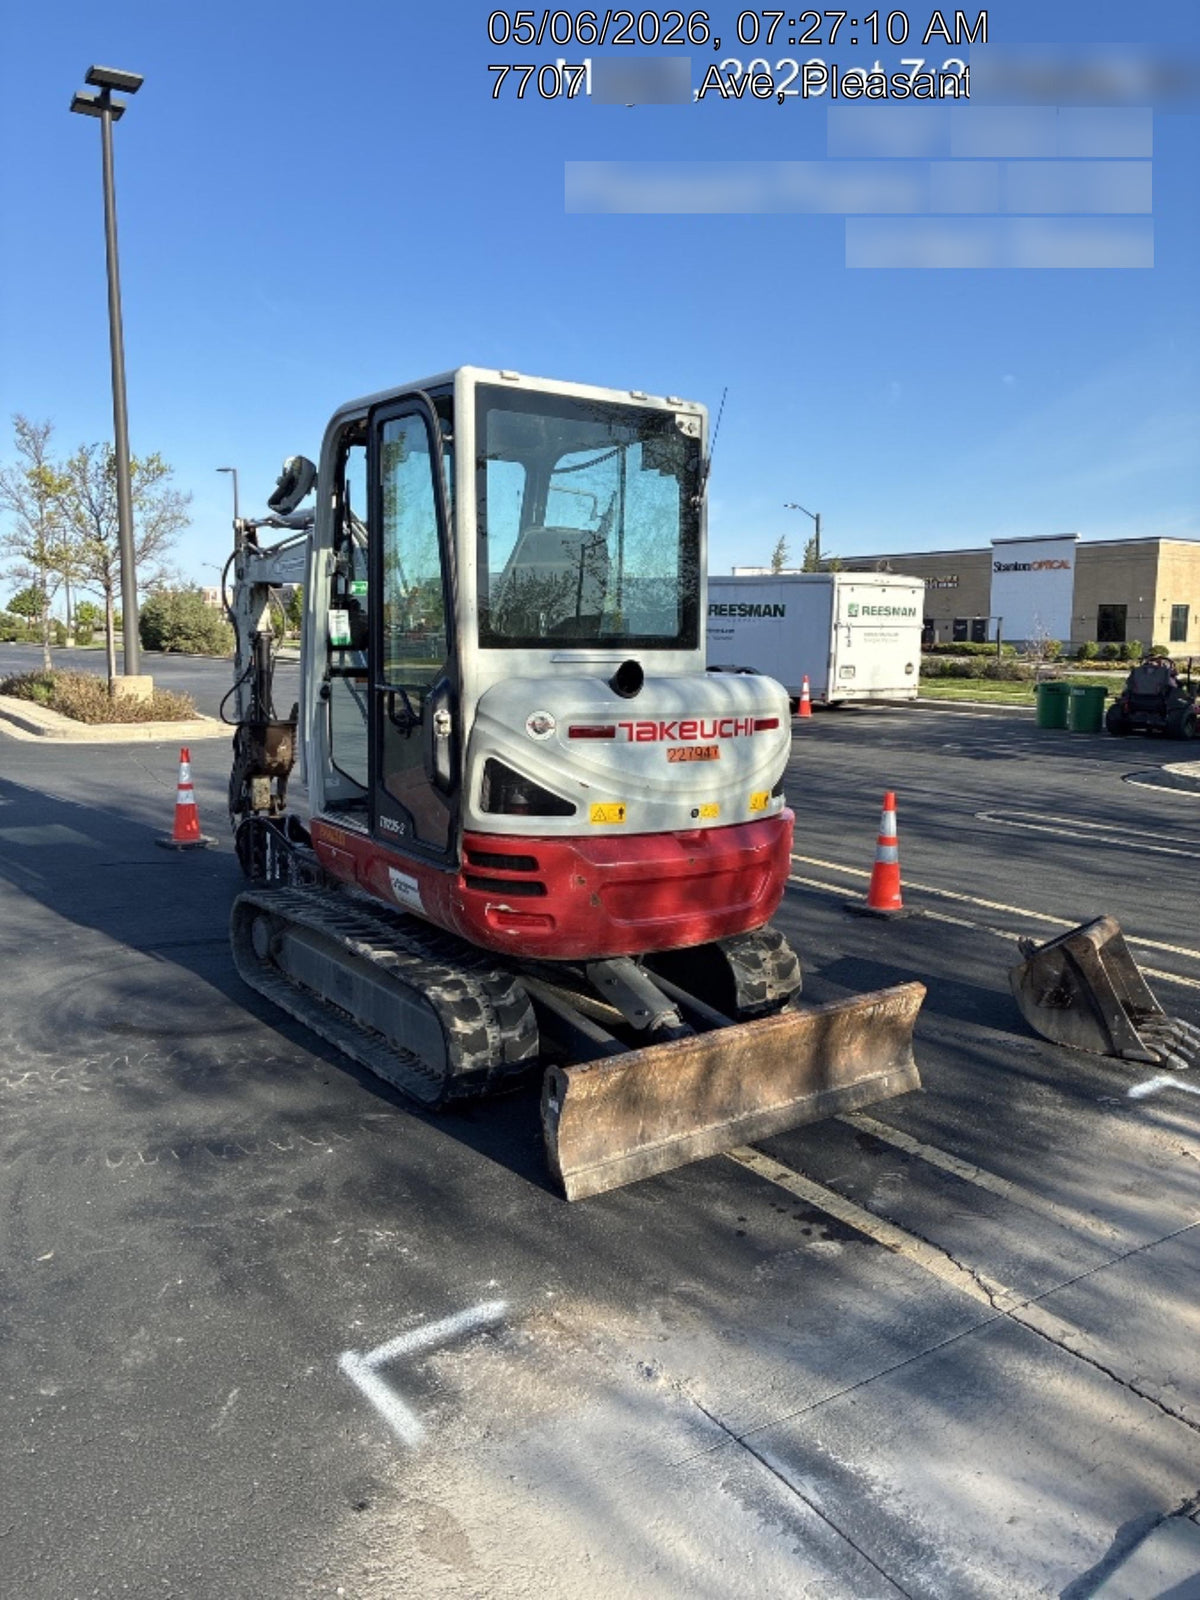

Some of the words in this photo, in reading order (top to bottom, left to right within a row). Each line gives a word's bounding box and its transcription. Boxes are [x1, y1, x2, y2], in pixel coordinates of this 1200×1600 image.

[708, 603, 786, 618] REESMAN
[861, 605, 917, 617] REESMAN
[618, 717, 754, 742] TAKEUCHI
